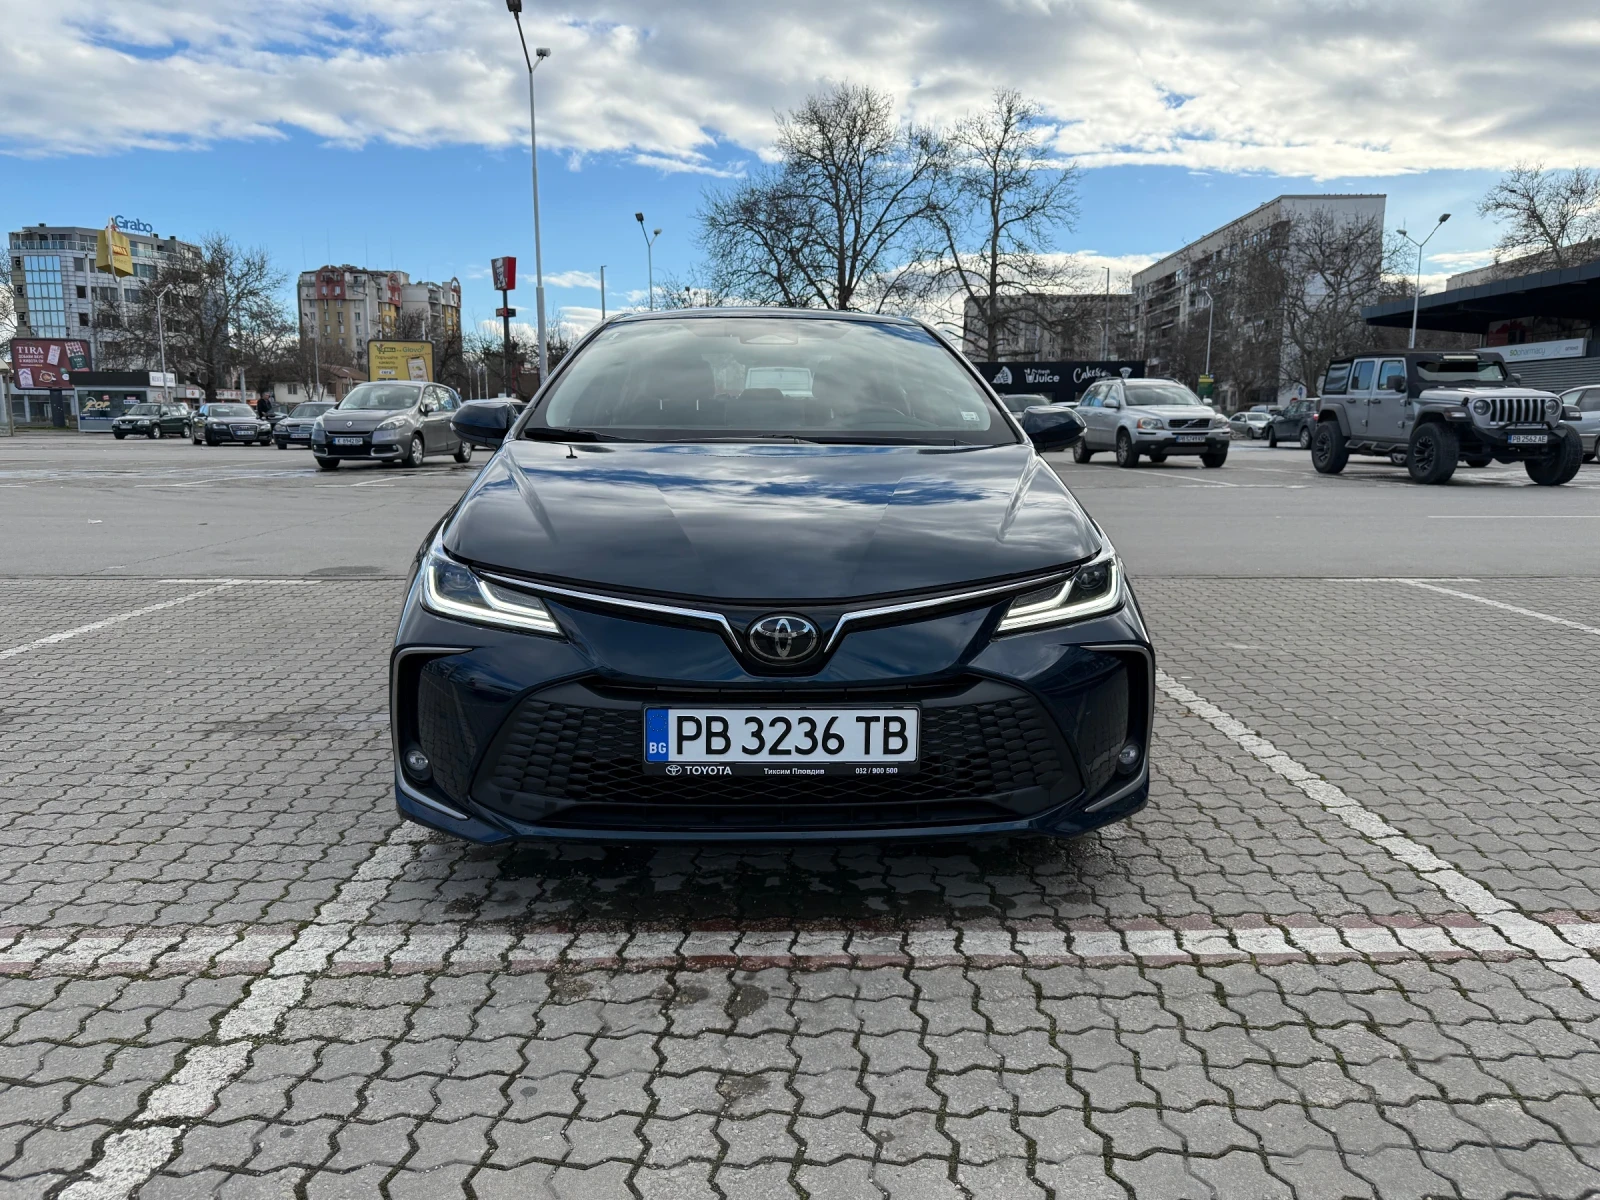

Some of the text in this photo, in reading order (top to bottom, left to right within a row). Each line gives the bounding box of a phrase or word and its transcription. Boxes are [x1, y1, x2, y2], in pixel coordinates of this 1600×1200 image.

[114, 215, 153, 233] Grabo
[16, 346, 44, 355] TIRA
[1034, 374, 1060, 383] Juice
[1072, 366, 1102, 384] Cakes
[676, 716, 908, 756] PB 3236 TB
[649, 742, 667, 754] BG
[685, 766, 732, 775] TOYOTA
[792, 768, 824, 776] Пловдив
